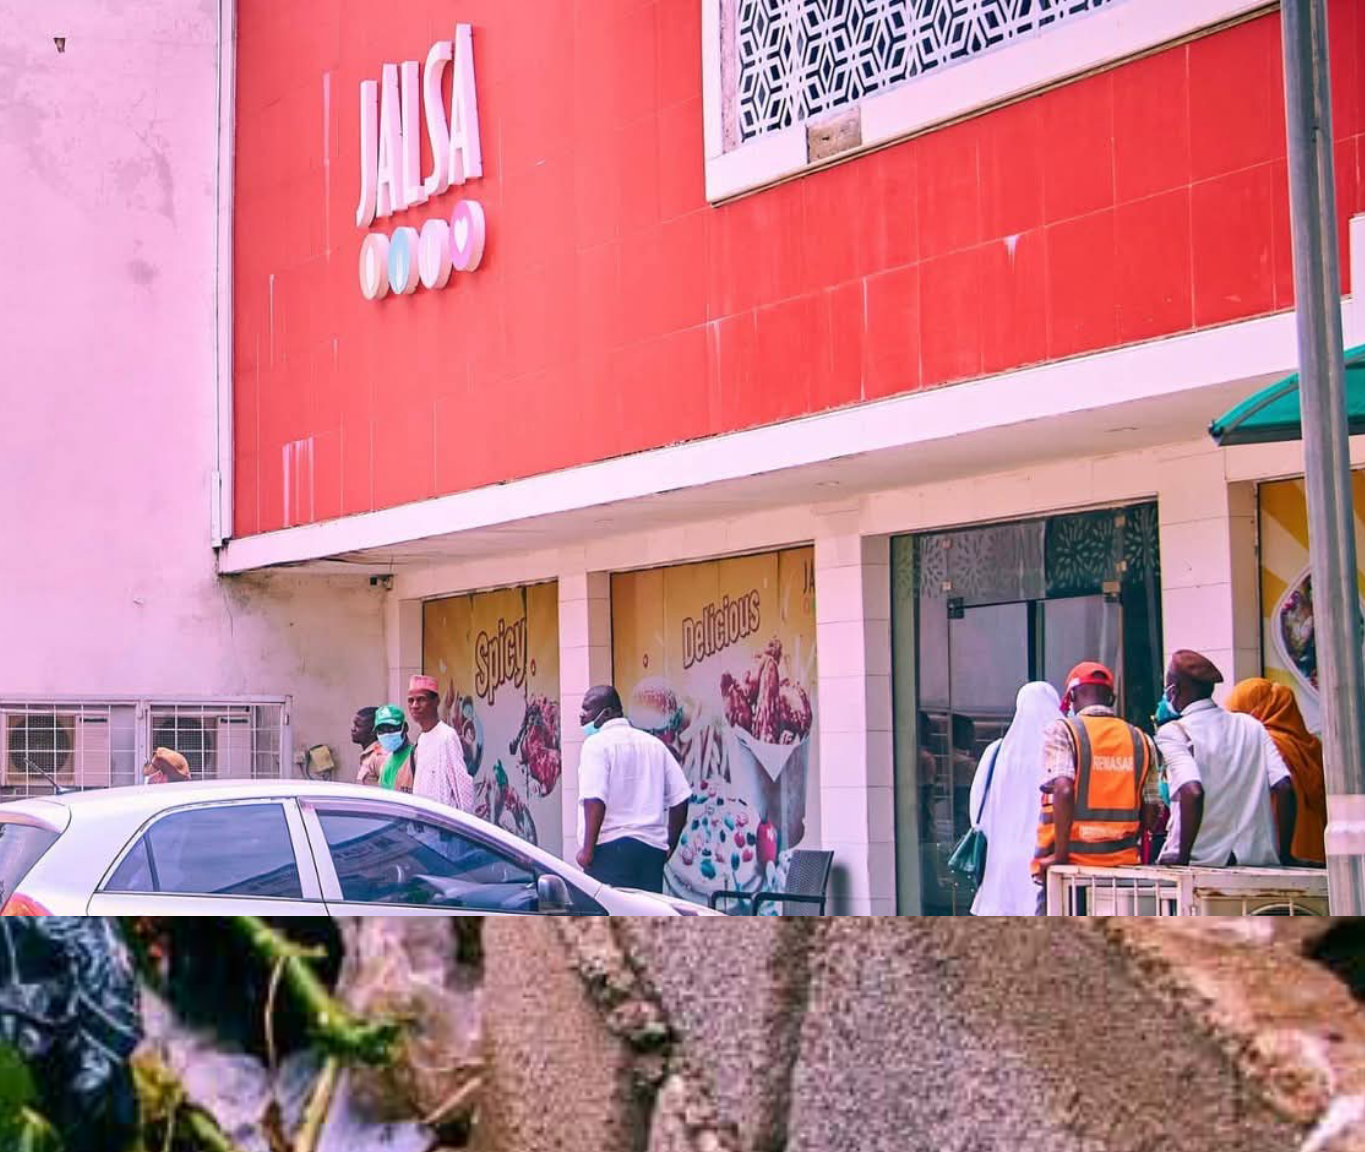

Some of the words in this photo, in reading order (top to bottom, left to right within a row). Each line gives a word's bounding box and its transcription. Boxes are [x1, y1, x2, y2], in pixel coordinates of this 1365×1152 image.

[356, 23, 483, 228] JALSA
[474, 617, 527, 706] Spicy
[682, 589, 760, 670] Delicious
